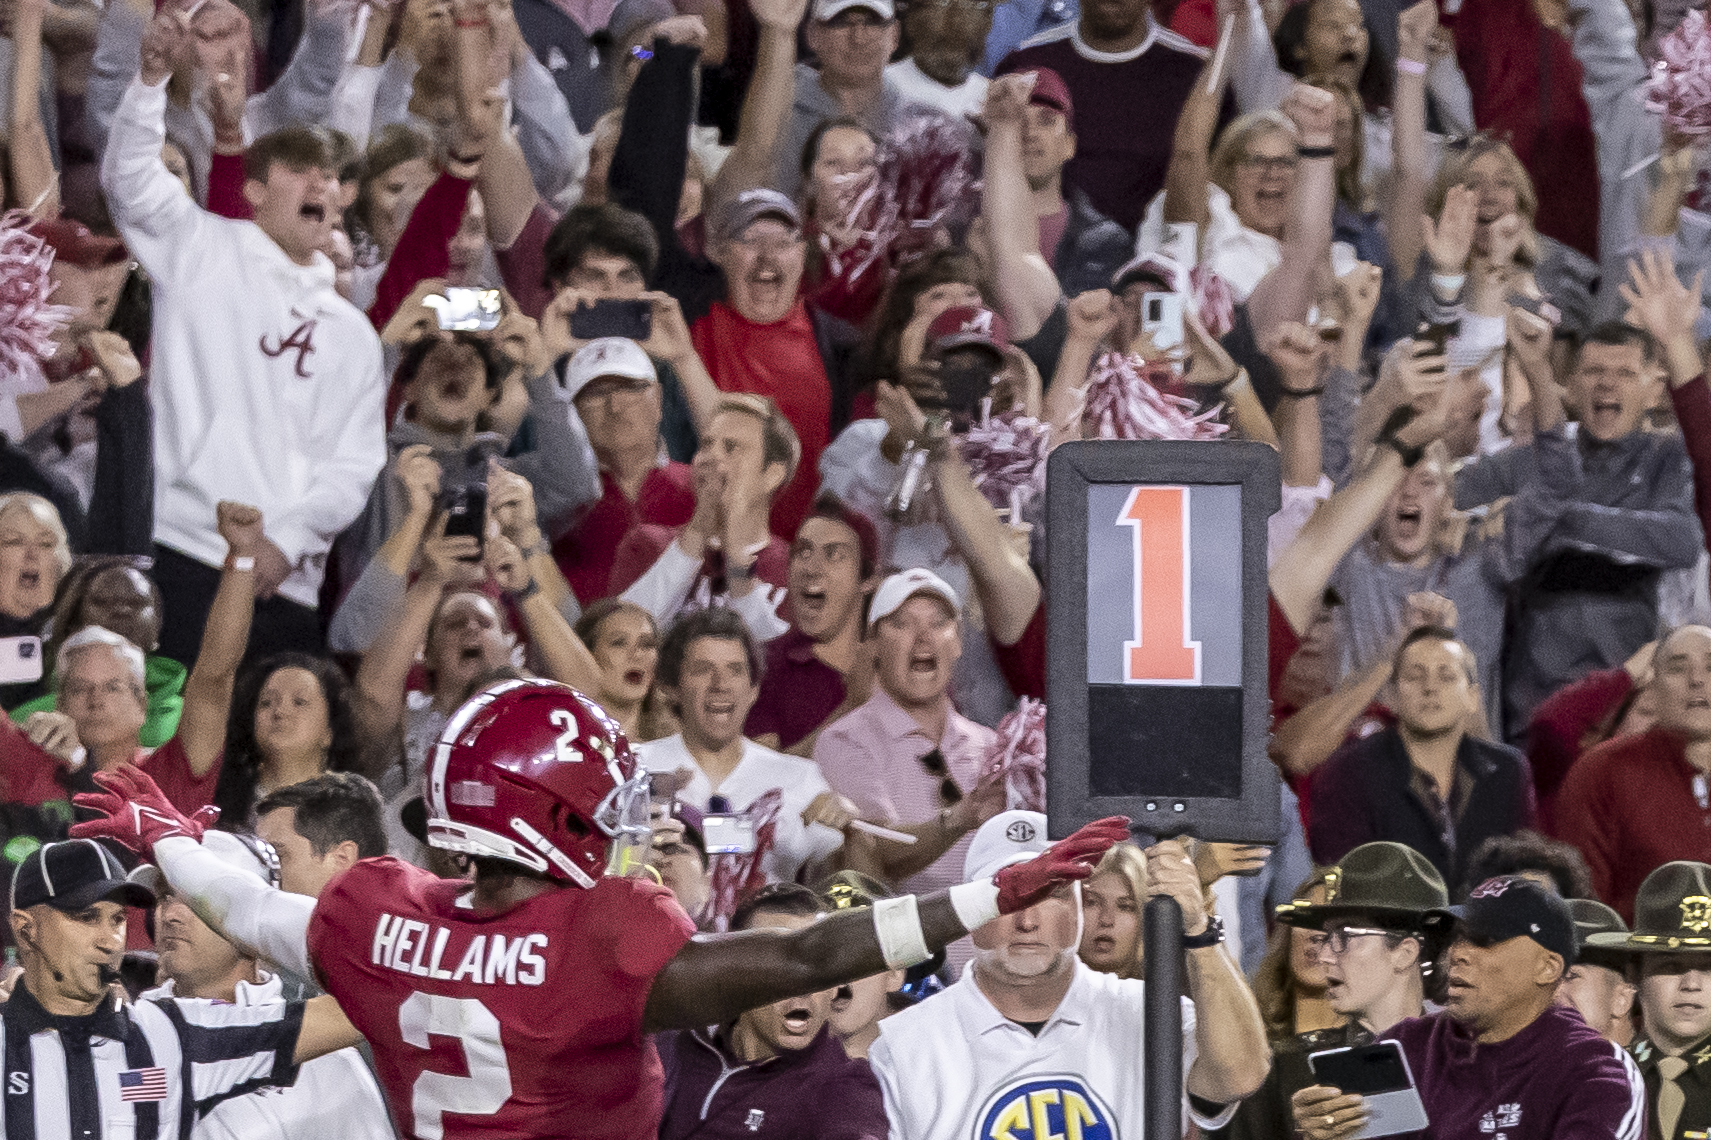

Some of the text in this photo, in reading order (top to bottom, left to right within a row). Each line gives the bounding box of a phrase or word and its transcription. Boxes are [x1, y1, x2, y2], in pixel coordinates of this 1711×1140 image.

[1115, 485, 1202, 685] 1
[550, 709, 584, 762] 2
[371, 913, 549, 985] HELLAMS
[8, 1071, 29, 1095] S
